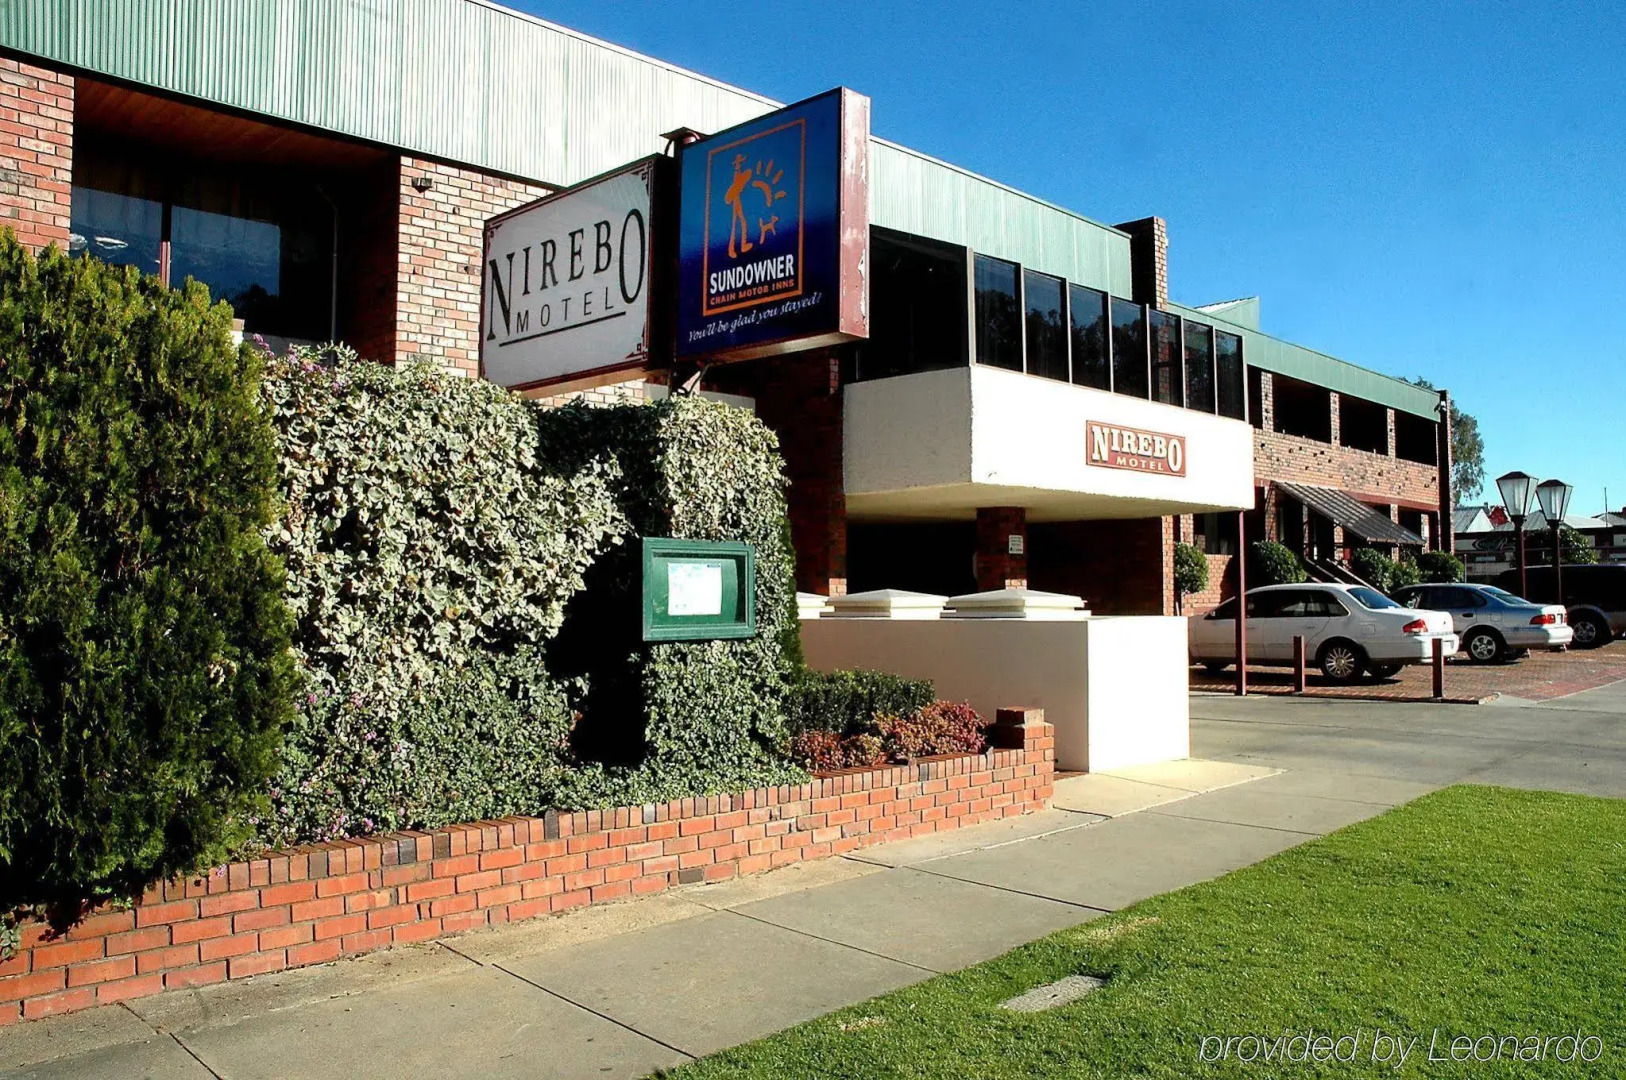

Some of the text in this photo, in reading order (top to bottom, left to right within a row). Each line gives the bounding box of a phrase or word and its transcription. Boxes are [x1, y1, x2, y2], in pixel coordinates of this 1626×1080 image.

[487, 208, 646, 341] NIREBO
[709, 254, 795, 294] SUNDOWNER
[709, 279, 795, 306] CHAIN MOTOR INNS
[516, 286, 614, 334] MOTEL
[717, 319, 730, 334] be
[730, 309, 757, 333] glad
[757, 306, 778, 325] you
[780, 291, 823, 314] stayed!
[1091, 424, 1183, 473] NIREBO
[1116, 456, 1164, 471] MOTEL
